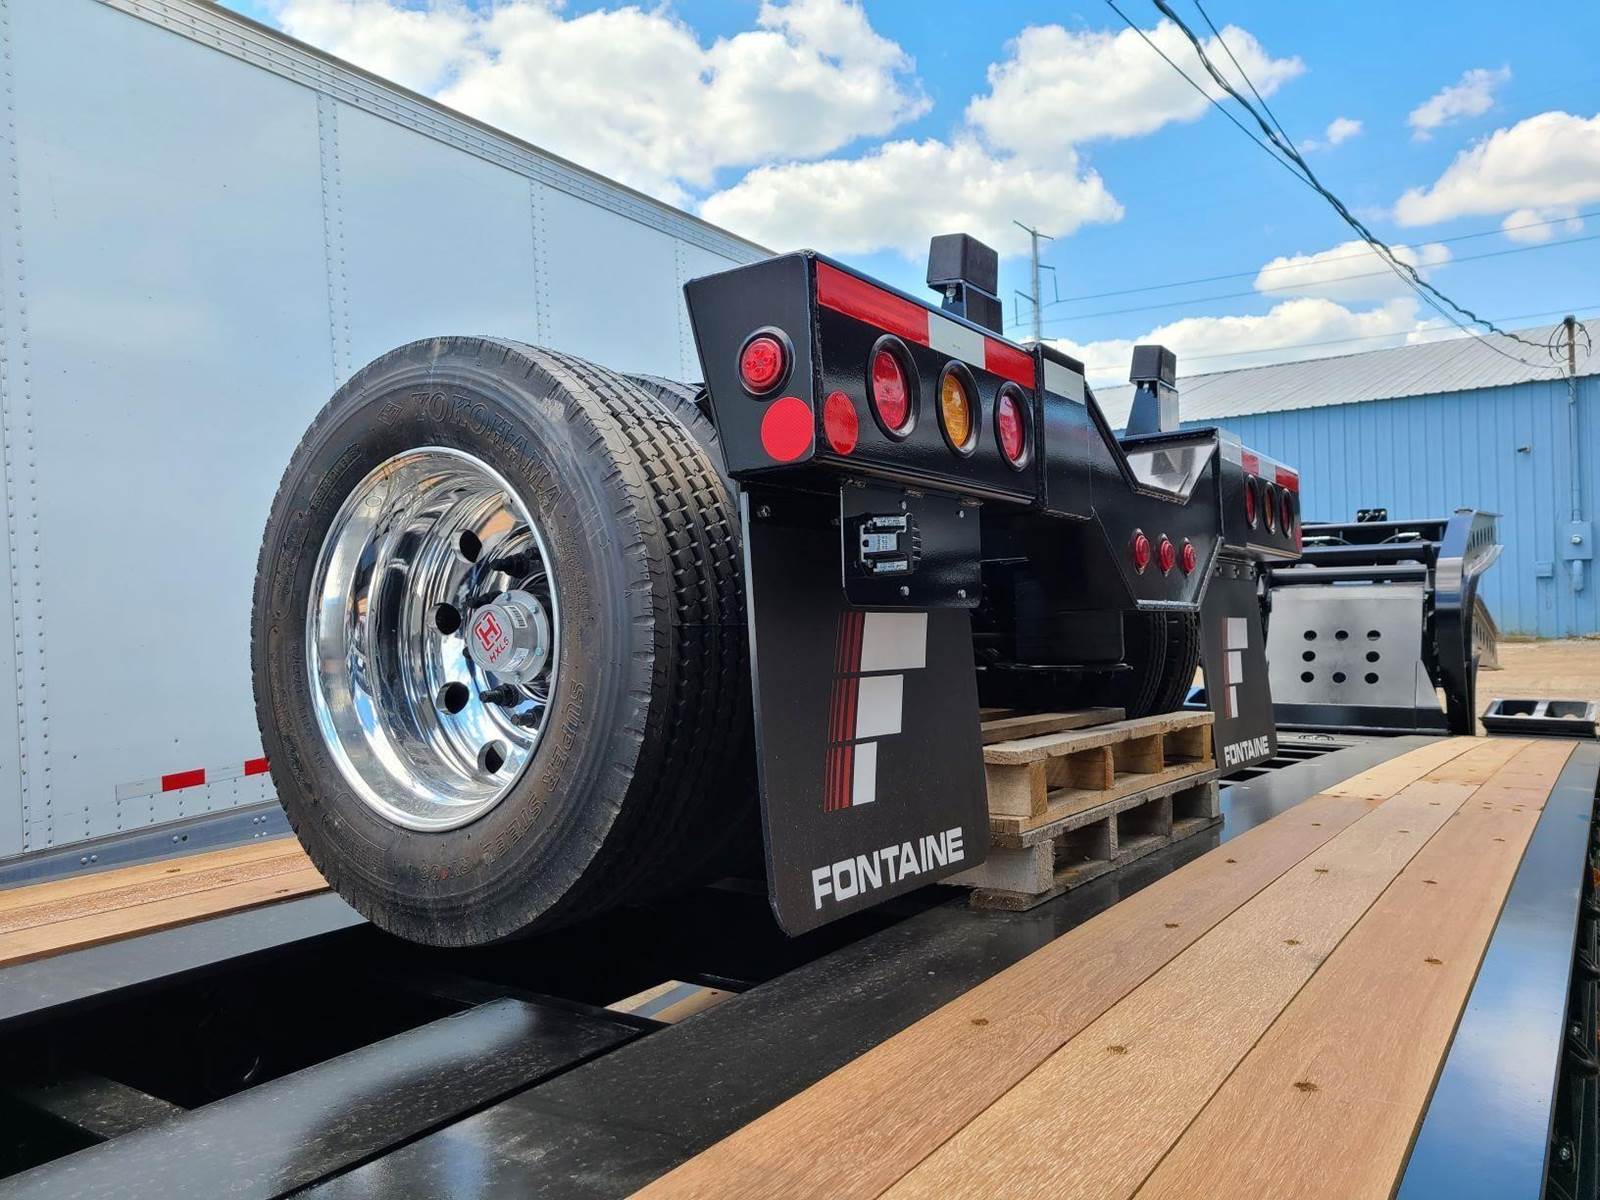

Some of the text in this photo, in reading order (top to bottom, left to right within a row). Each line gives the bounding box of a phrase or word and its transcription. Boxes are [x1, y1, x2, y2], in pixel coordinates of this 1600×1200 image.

[411, 391, 562, 516] YOKOHAMA
[542, 680, 585, 793] SUPER
[1223, 735, 1270, 768] FONTAINE
[481, 794, 548, 870] STEEL
[811, 826, 965, 910] FONTAINE
